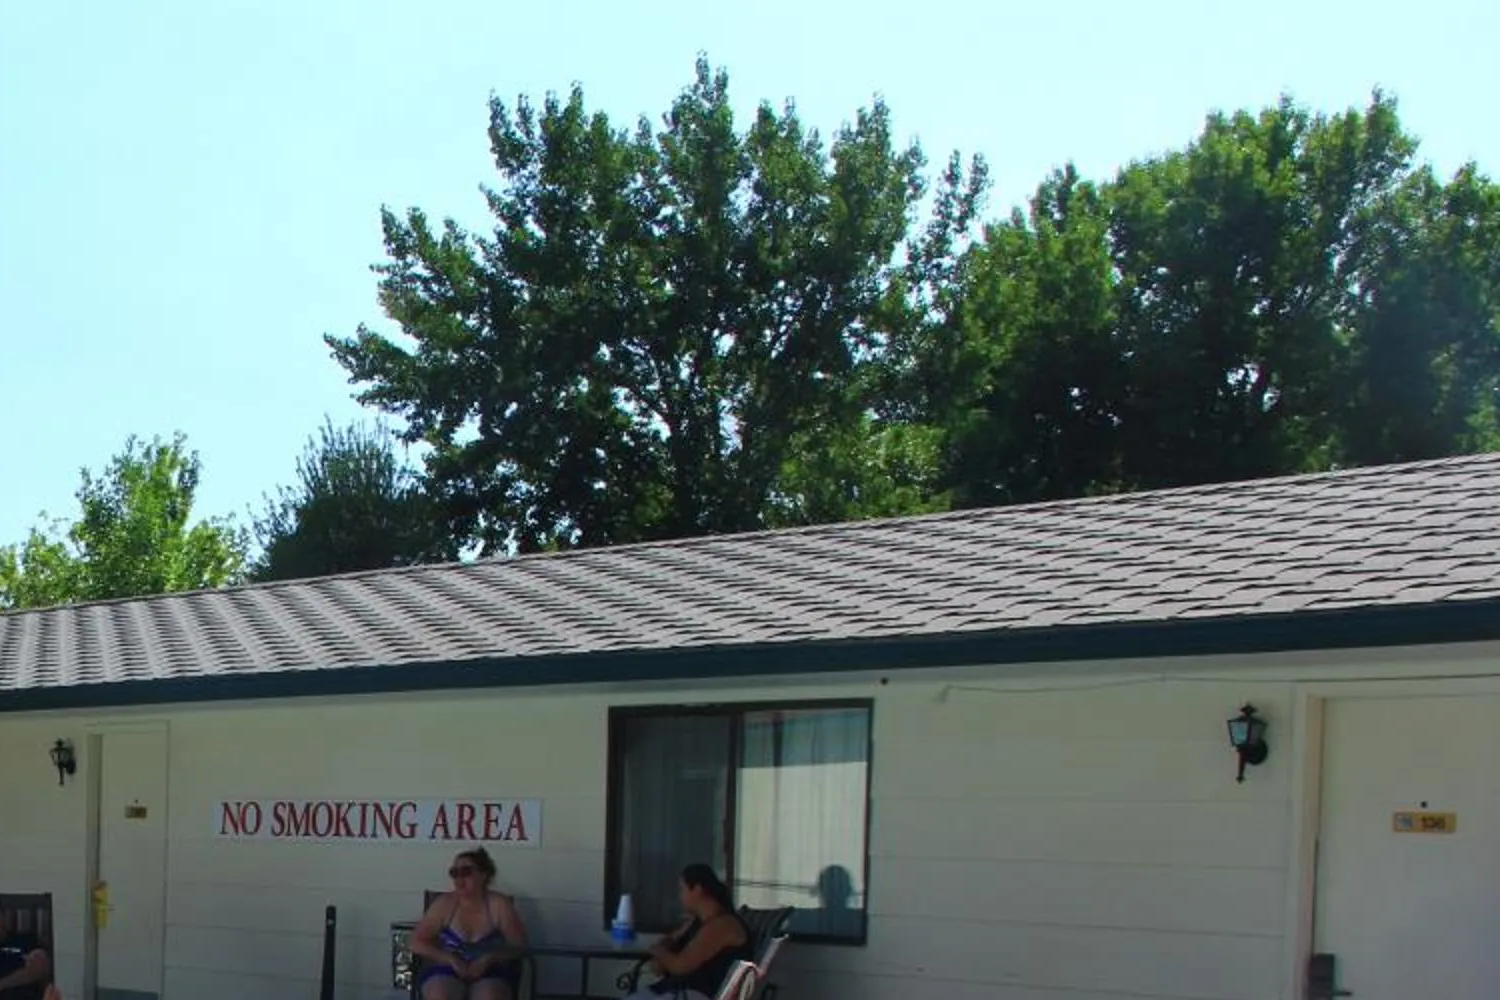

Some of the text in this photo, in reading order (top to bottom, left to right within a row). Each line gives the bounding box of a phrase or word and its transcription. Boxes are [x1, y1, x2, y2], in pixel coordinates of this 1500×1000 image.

[220, 801, 529, 841] NO SMOKING AREA
